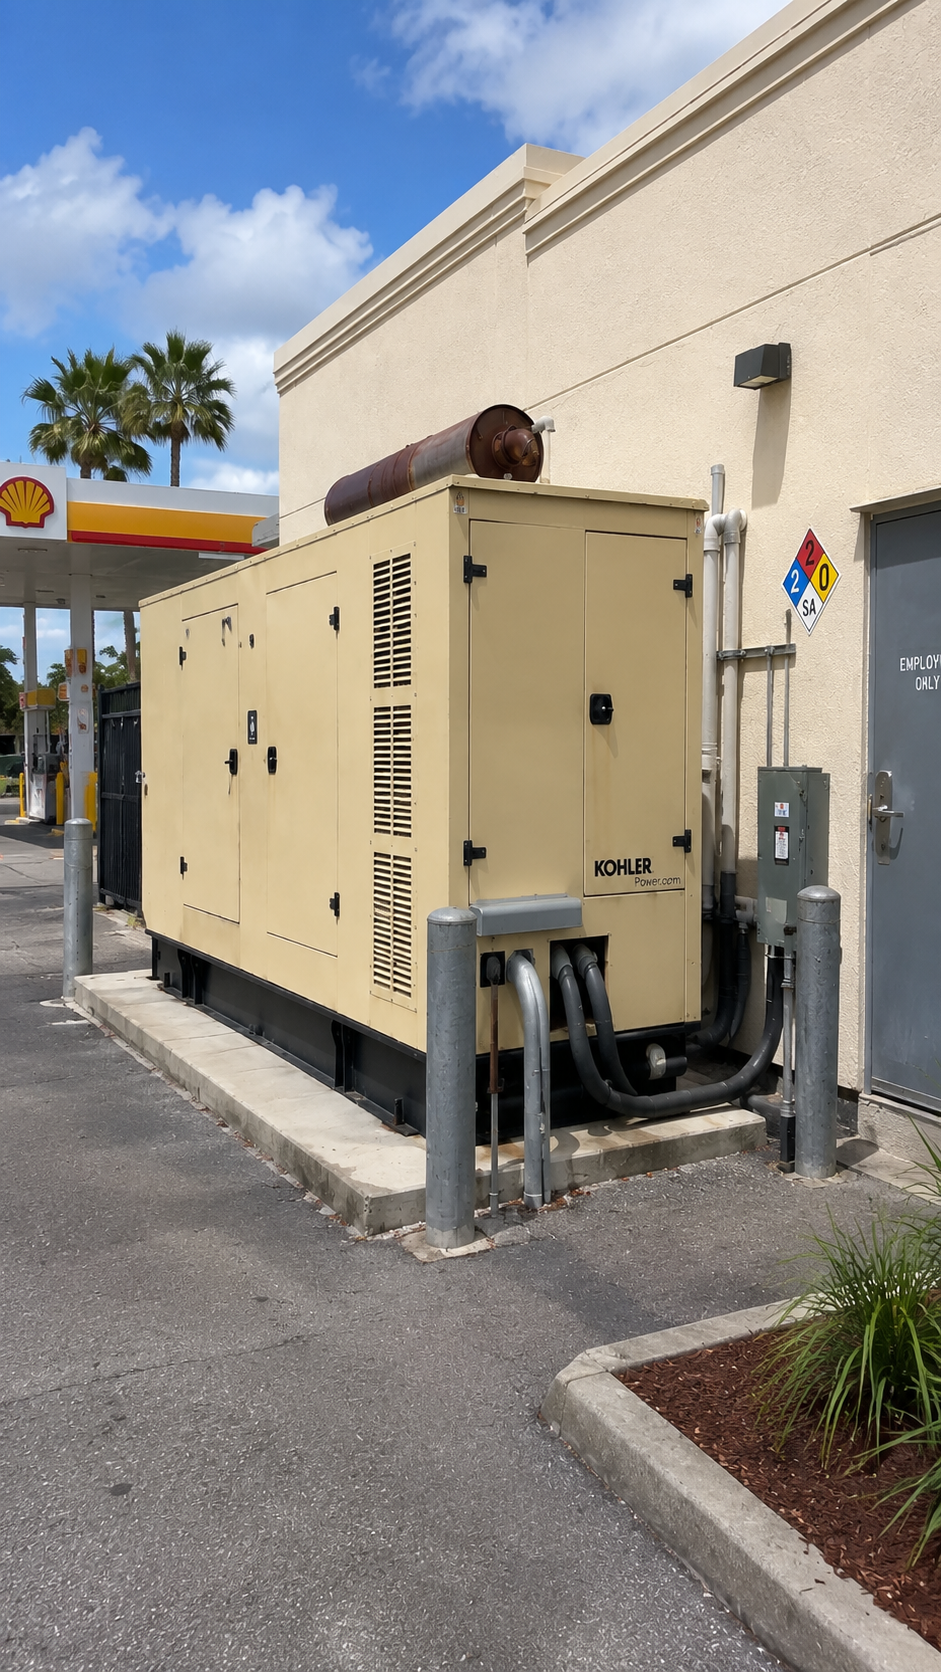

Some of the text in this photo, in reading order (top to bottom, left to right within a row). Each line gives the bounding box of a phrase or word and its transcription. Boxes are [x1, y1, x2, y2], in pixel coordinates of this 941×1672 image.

[805, 539, 815, 567] 2
[790, 569, 800, 594] 2
[819, 563, 829, 592] 0
[802, 598, 816, 617] SA
[899, 654, 941, 672] EMPLOY
[594, 857, 652, 877] KOHLER
[634, 876, 681, 887] Power.com
